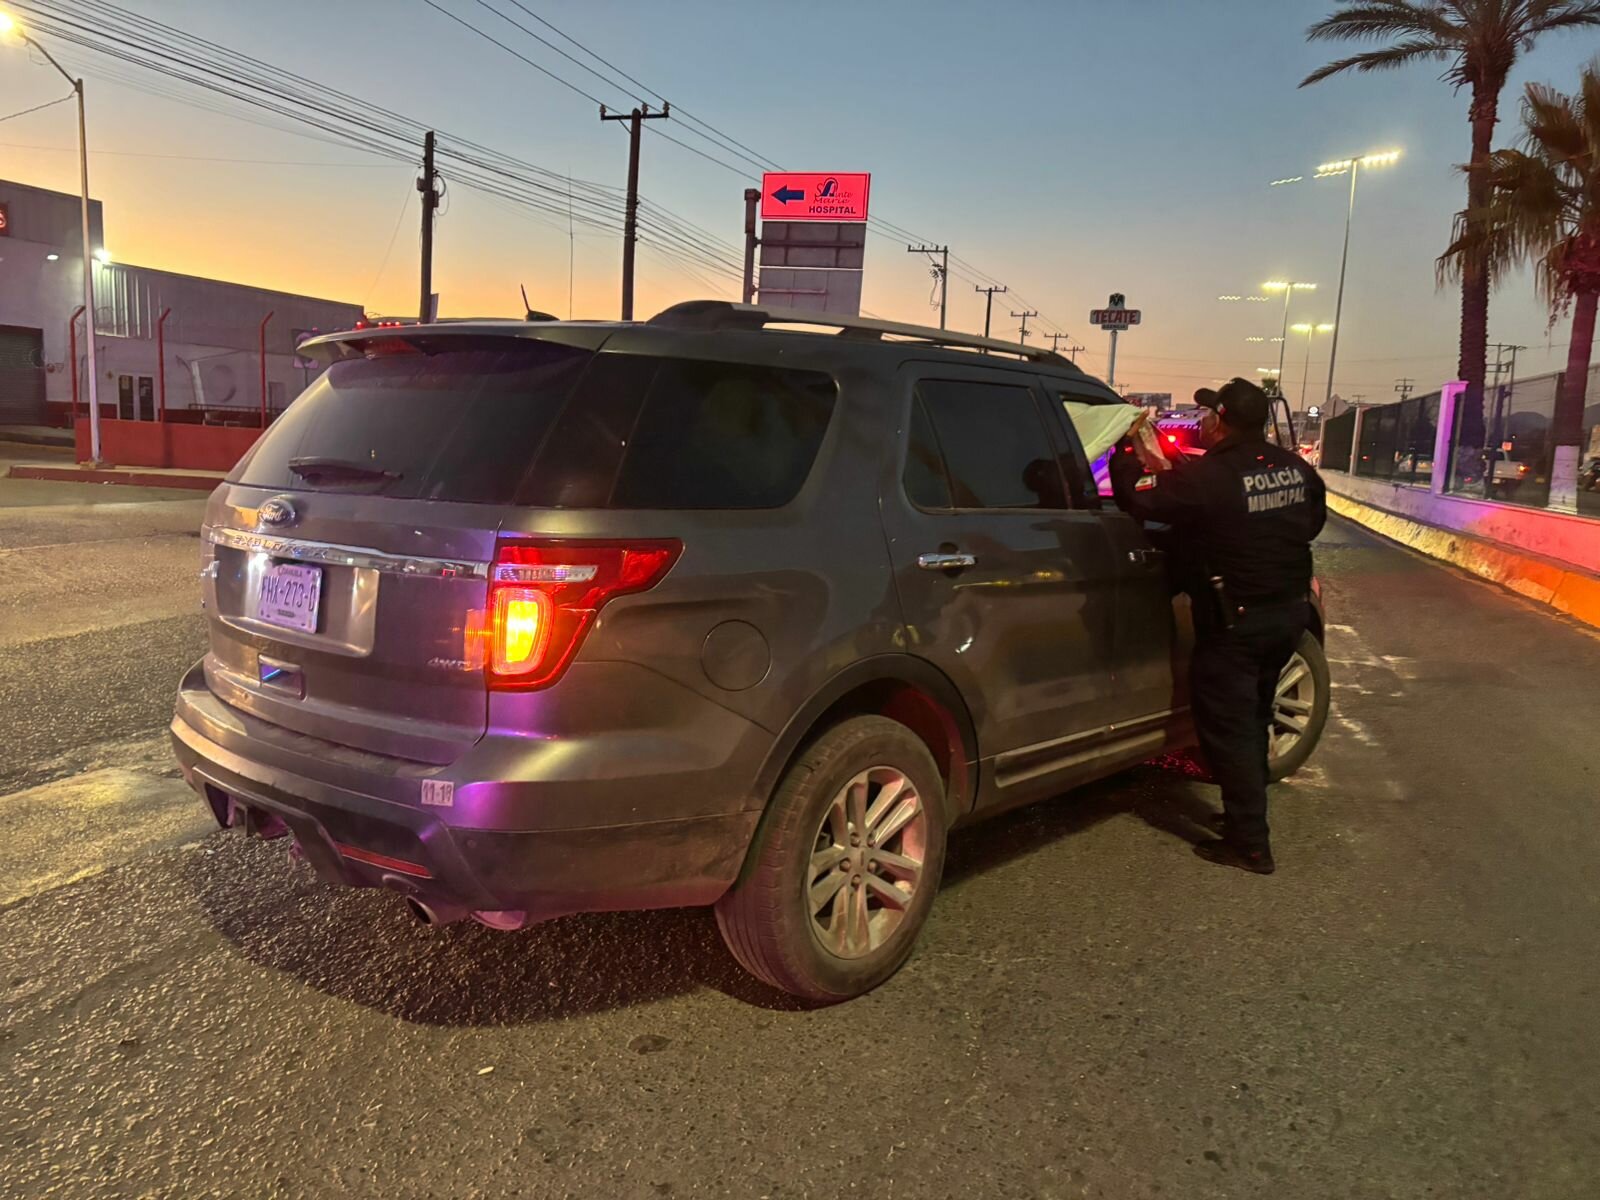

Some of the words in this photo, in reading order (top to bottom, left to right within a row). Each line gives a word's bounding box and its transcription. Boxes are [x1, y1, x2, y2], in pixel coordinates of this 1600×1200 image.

[809, 205, 857, 215] HOSPITAL
[1091, 309, 1138, 324] TECATE
[1243, 466, 1304, 492] POLICÍA
[1247, 486, 1305, 513] MUNICIPAL
[260, 503, 287, 521] Ford
